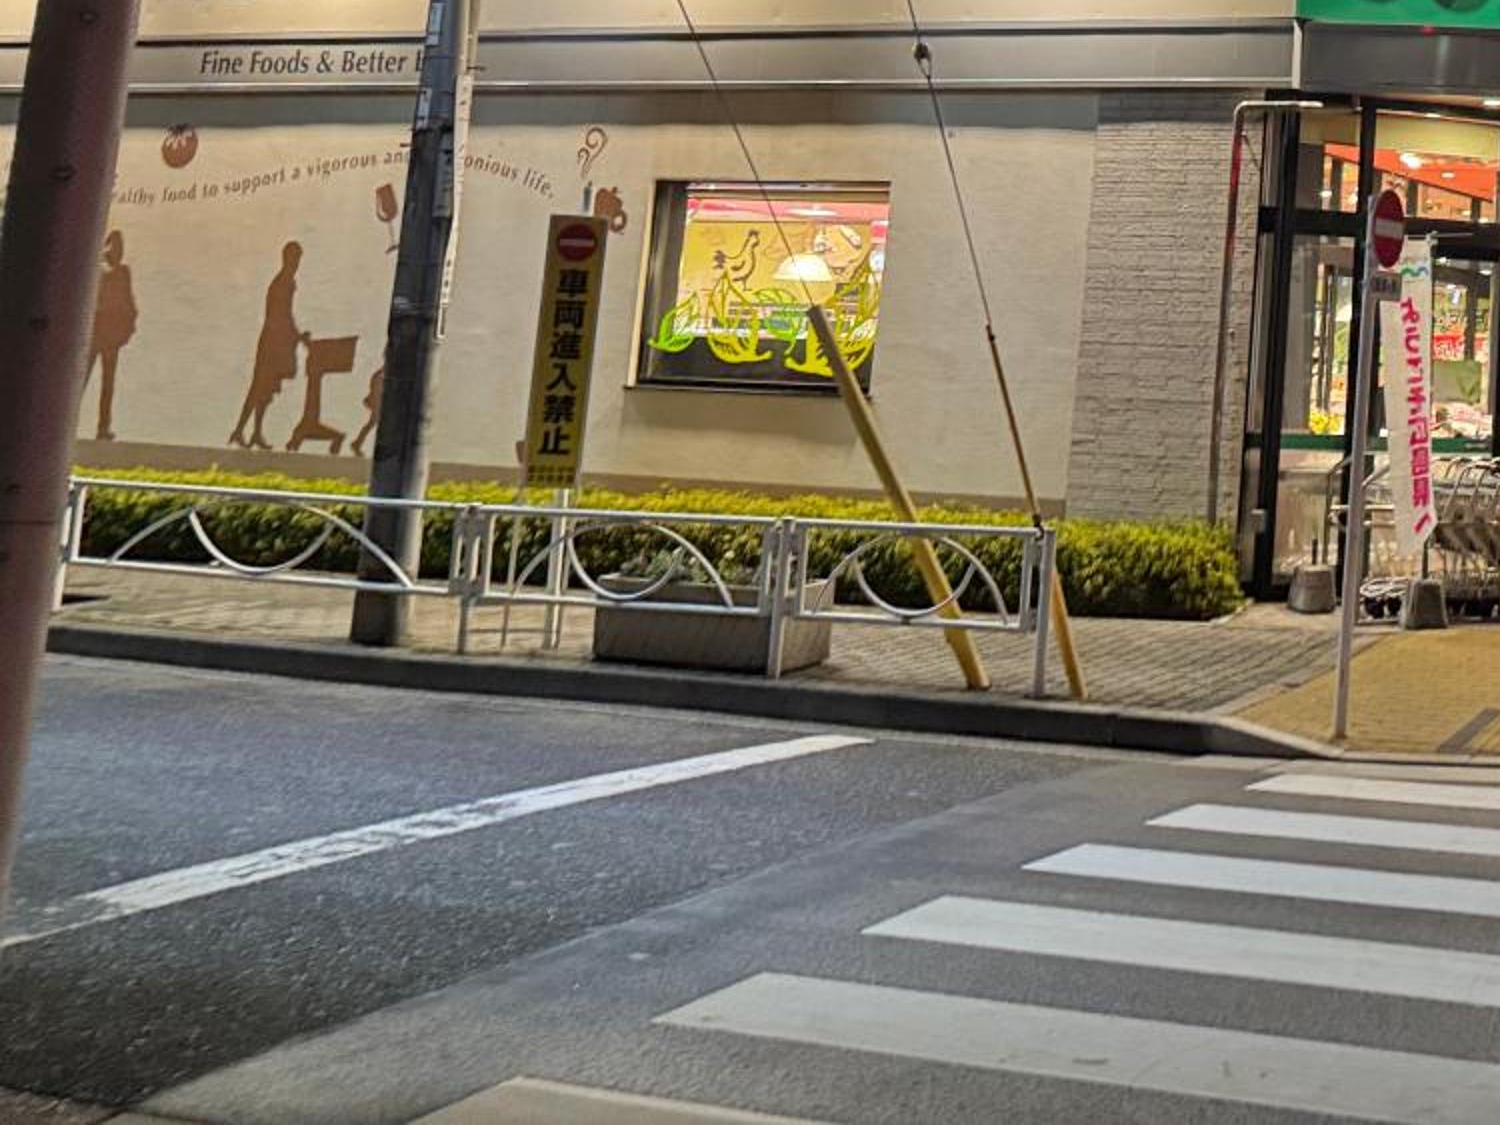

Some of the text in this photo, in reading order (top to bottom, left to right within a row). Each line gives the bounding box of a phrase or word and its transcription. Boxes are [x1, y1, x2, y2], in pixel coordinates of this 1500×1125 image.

[200, 50, 242, 75] Fine
[250, 49, 309, 74] Foods
[316, 51, 336, 73] &
[341, 49, 408, 74] Better
[203, 182, 219, 197] to
[224, 168, 286, 195] support
[291, 166, 302, 180] a
[307, 153, 378, 177] vigorous
[537, 268, 588, 456] 車両進入禁止
